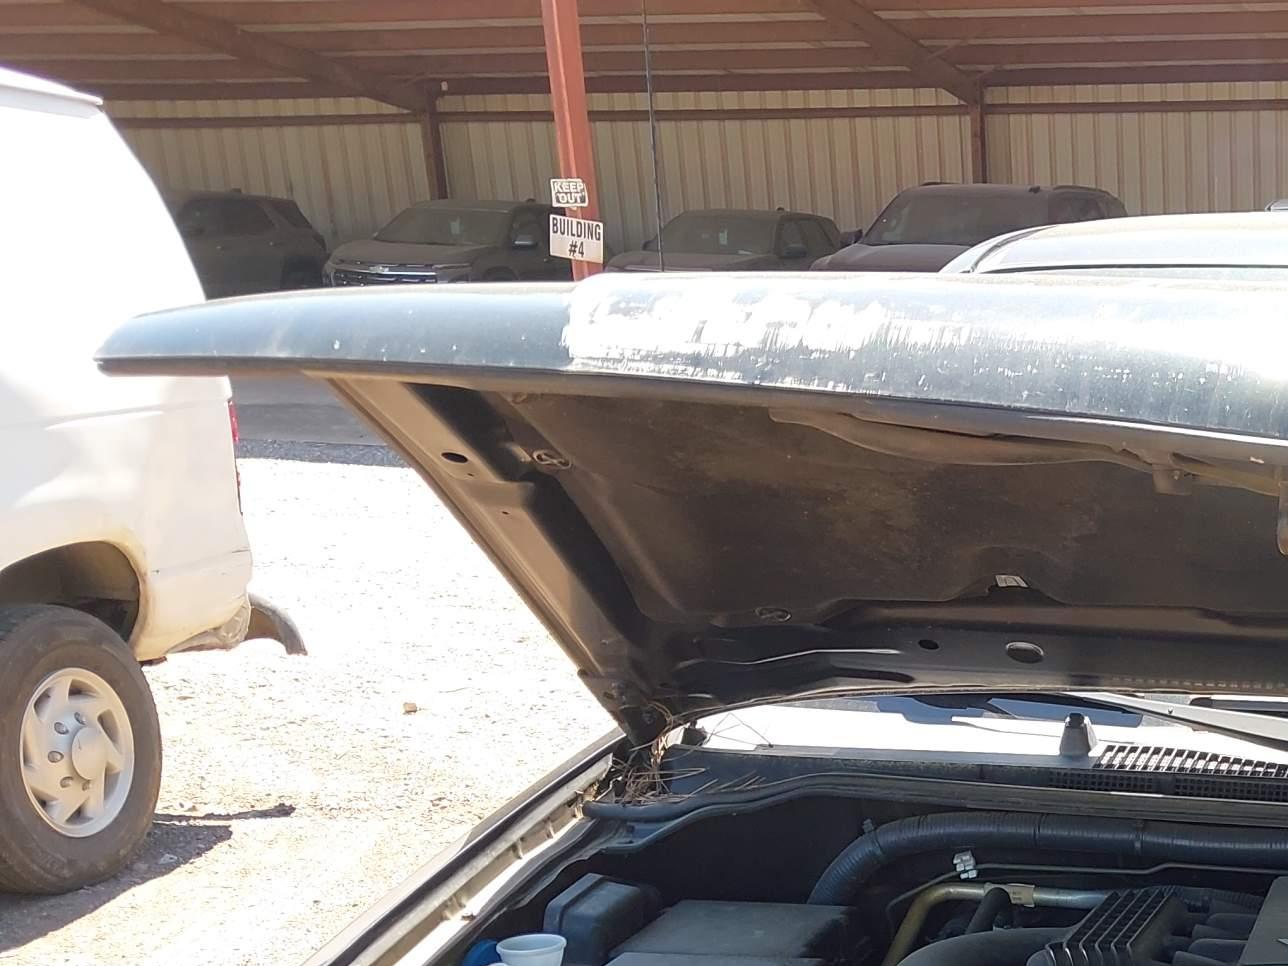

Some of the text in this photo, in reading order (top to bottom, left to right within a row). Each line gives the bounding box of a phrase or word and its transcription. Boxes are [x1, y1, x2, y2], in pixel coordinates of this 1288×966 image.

[553, 182, 584, 193] KEEP
[558, 192, 583, 204] OUT
[551, 217, 602, 241] BUILDING
[568, 240, 585, 258] #4
